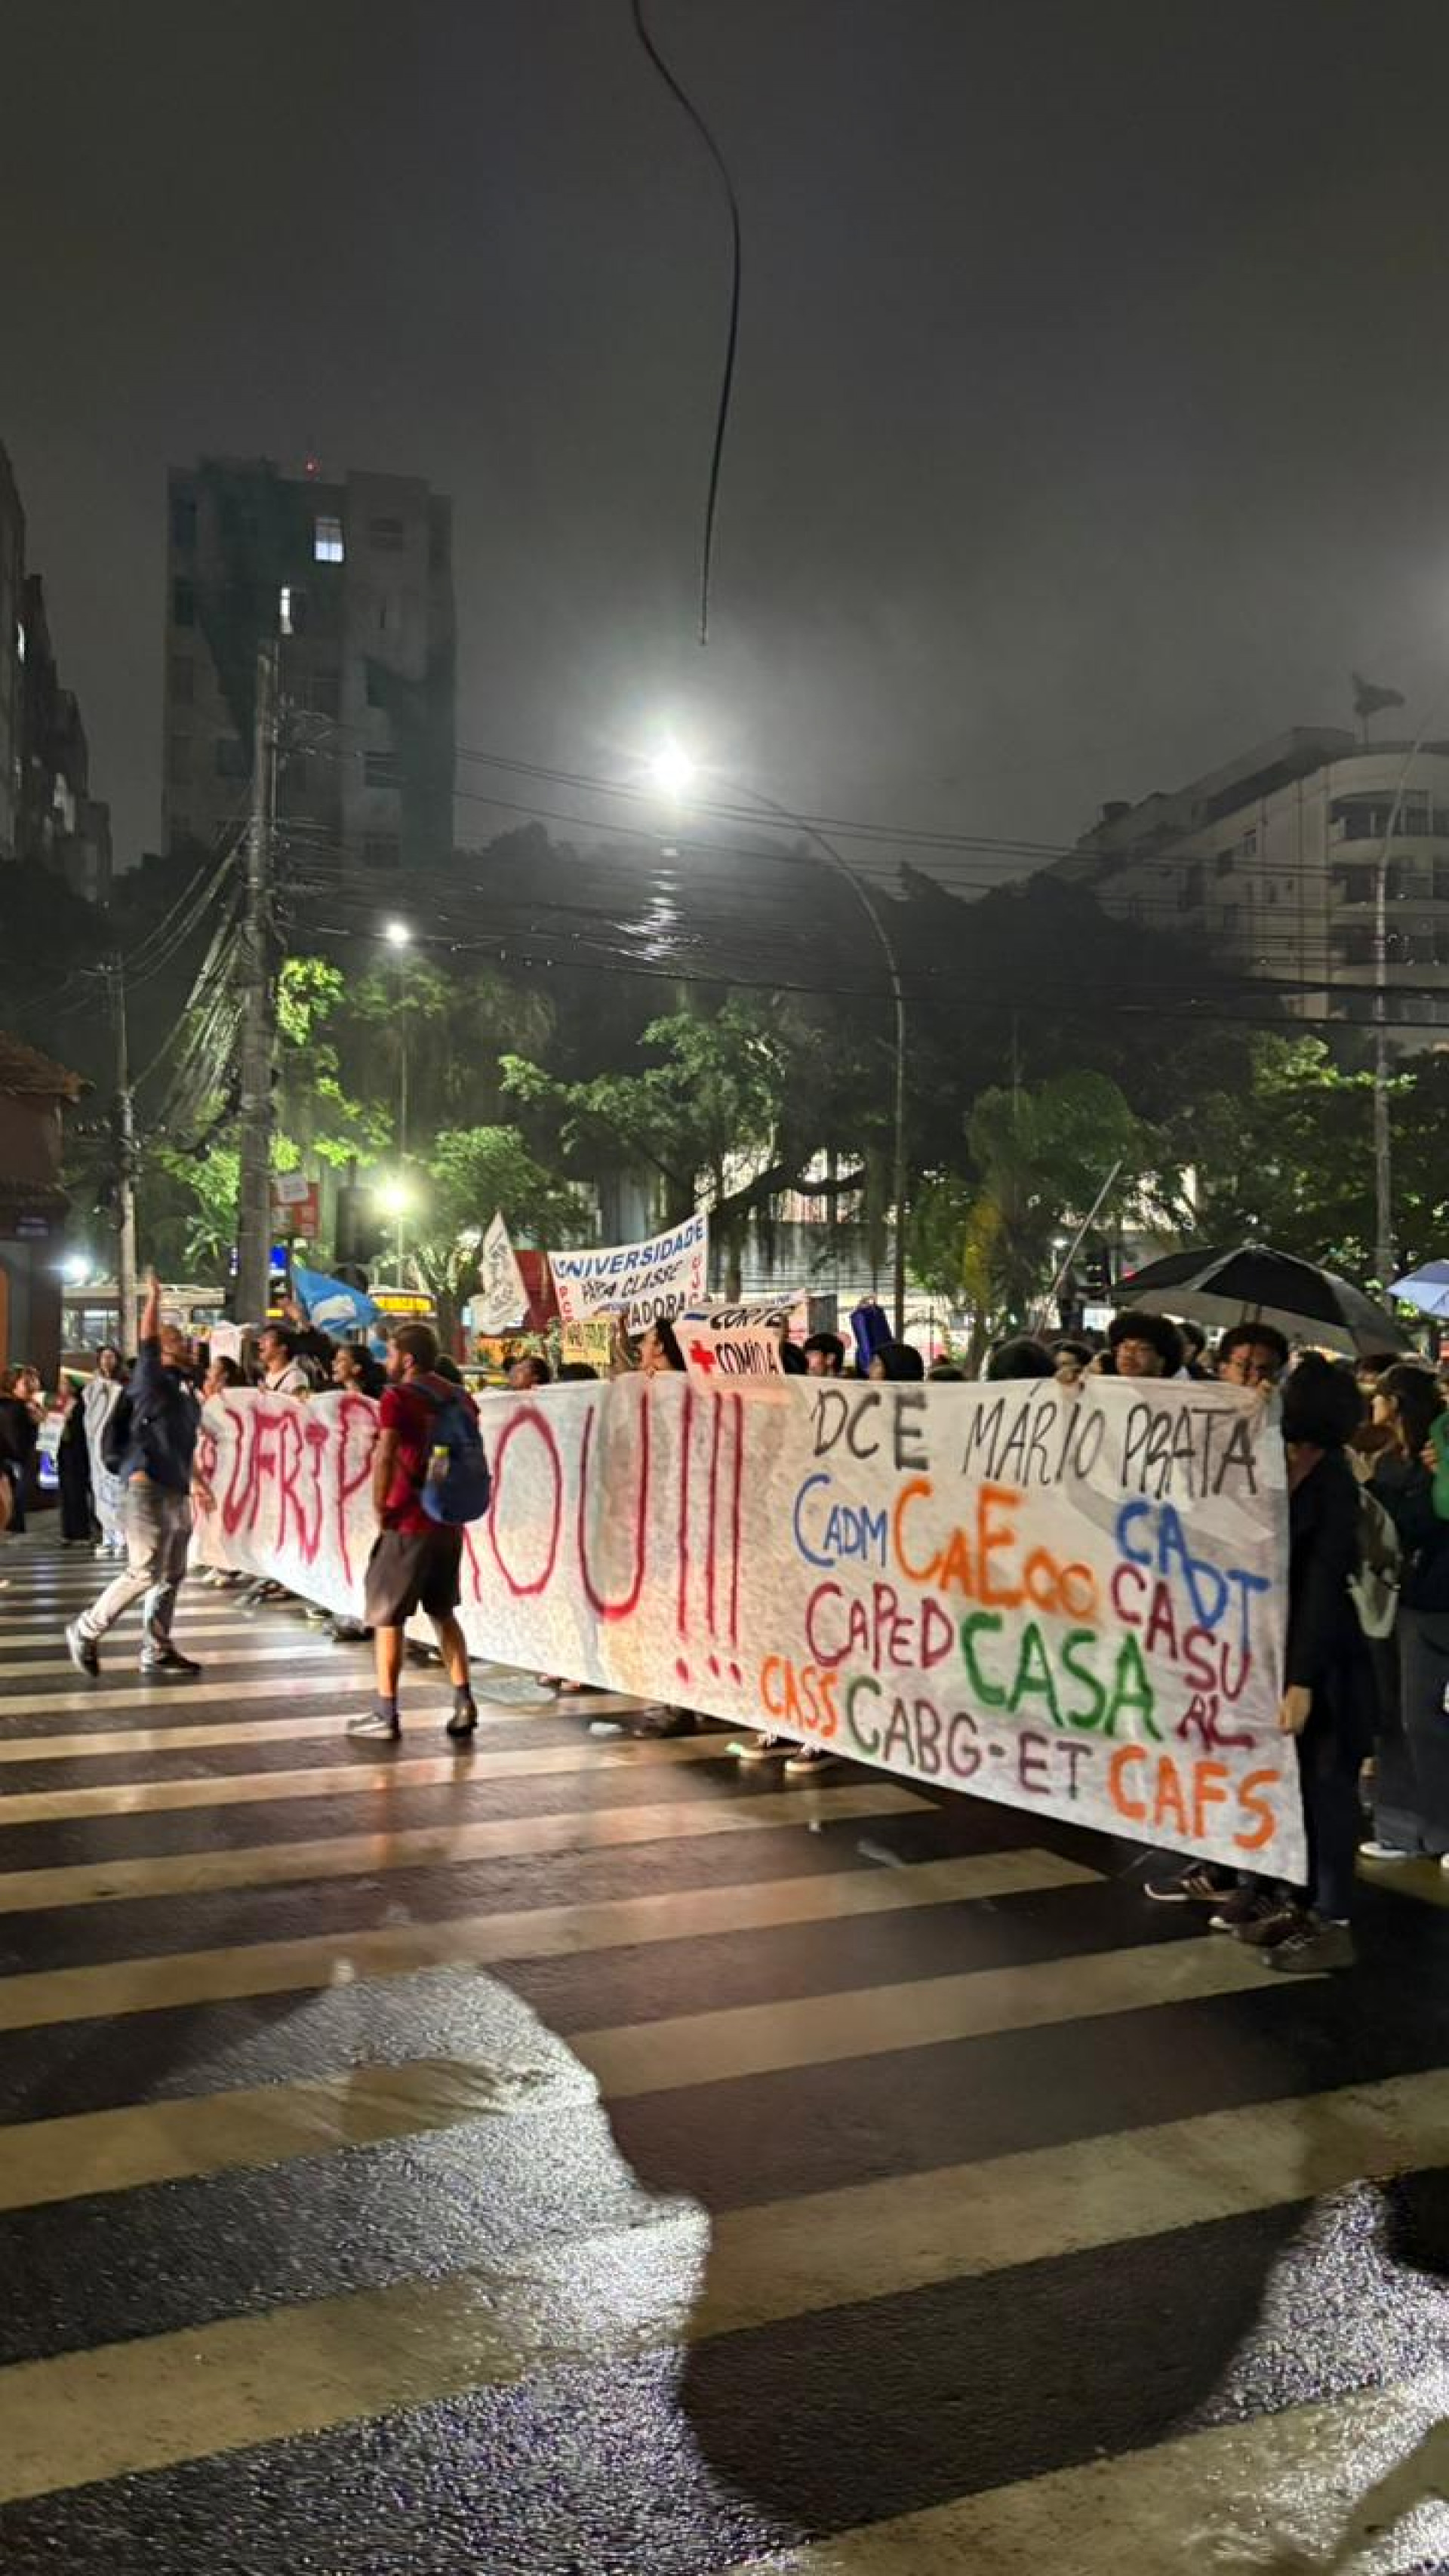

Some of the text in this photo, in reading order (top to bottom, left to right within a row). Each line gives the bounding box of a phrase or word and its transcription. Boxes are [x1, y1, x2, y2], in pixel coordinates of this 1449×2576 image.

[554, 1217, 703, 1279] UNIVERSIDADE
[811, 1380, 1258, 1500] DCE MÁRIO PRATA
[793, 1473, 889, 1568] CADM
[805, 1583, 955, 1671] CAPED
[1117, 1500, 1271, 1653] CADT
[960, 1611, 1162, 1740] CASA
[1112, 1564, 1251, 1700] CASU
[760, 1655, 839, 1737] CASS
[1107, 1745, 1280, 1851] CAFS
